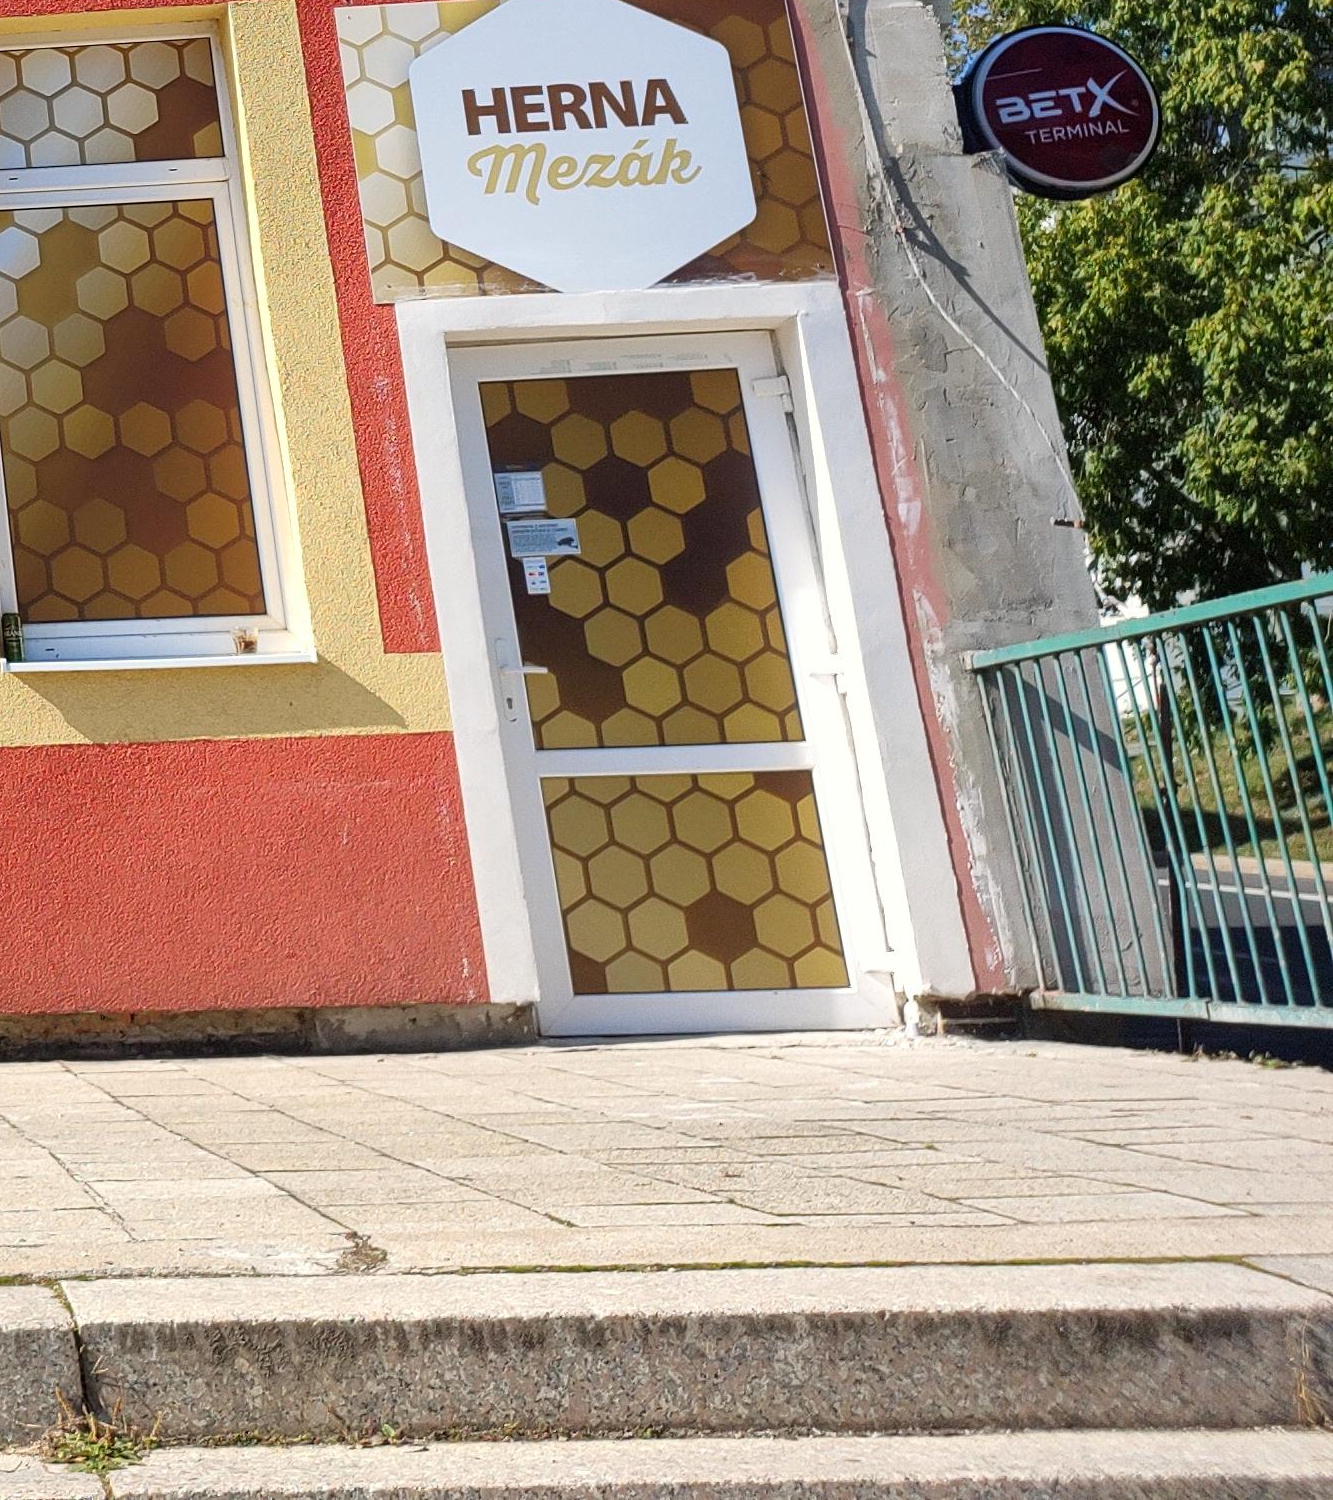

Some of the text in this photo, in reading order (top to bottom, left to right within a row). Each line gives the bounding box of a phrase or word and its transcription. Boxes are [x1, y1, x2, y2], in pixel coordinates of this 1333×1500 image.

[461, 78, 688, 136] HERNA
[996, 69, 1140, 124] BETX
[1025, 120, 1130, 145] TERMINAL
[468, 138, 702, 206] Mezák
